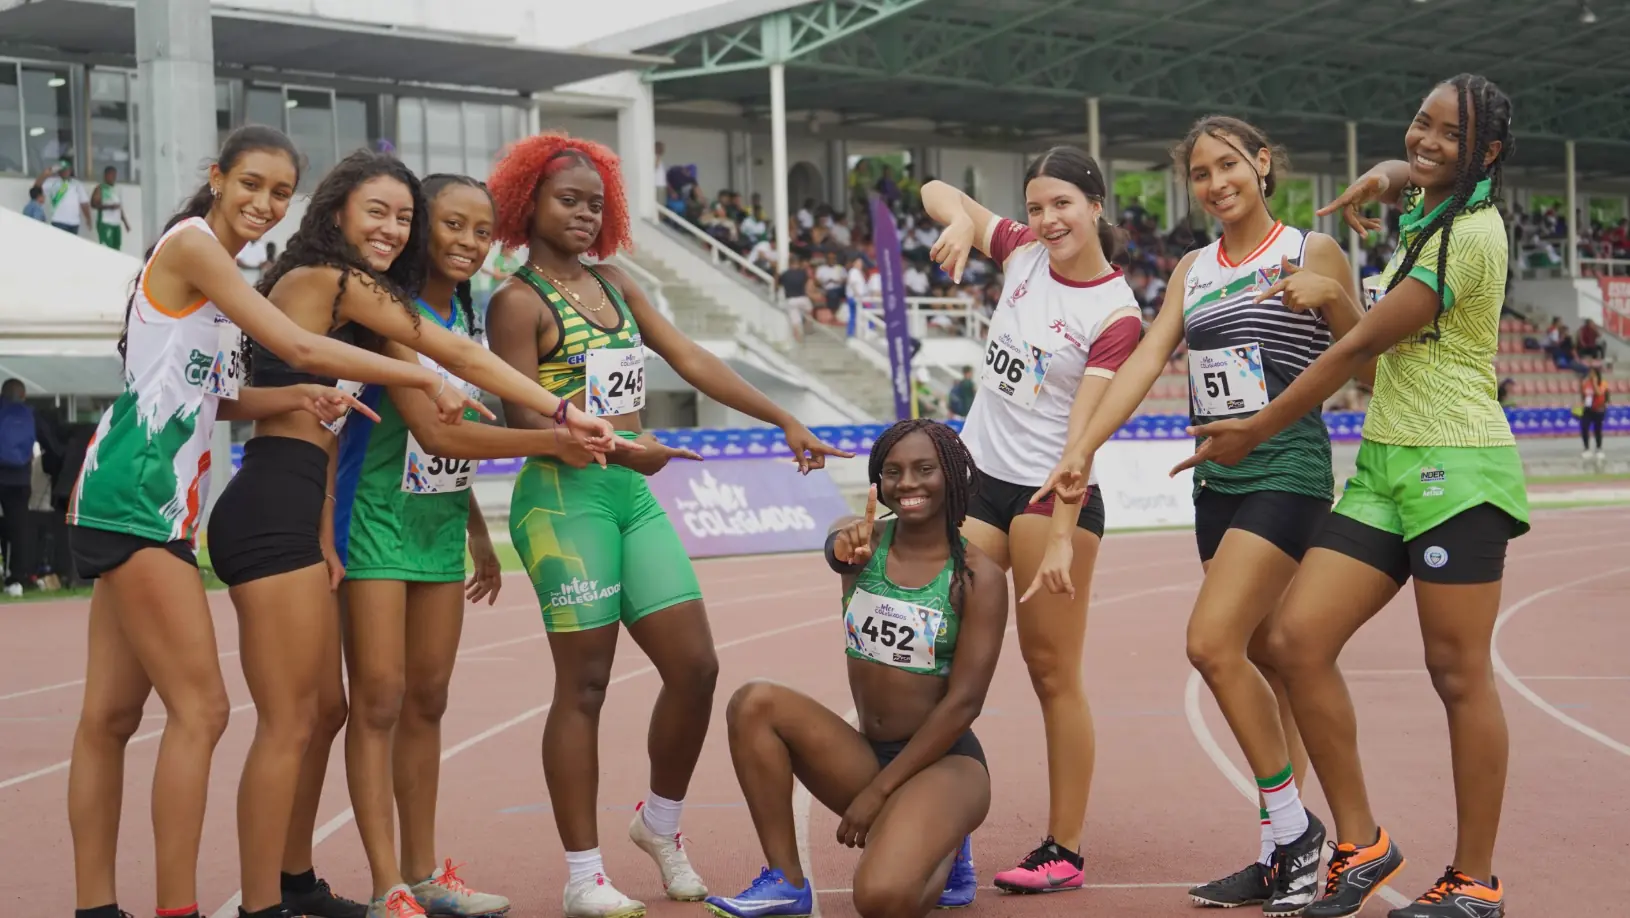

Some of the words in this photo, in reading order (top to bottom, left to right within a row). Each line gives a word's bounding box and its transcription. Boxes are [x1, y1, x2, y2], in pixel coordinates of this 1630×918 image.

[986, 340, 1025, 383] 506
[608, 367, 644, 398] 245
[1203, 371, 1230, 398] 51
[427, 454, 471, 476] 302
[1421, 470, 1445, 479] INDER
[684, 505, 815, 538] COLEGIADOS
[561, 576, 598, 595] Inter
[861, 616, 915, 651] 452
